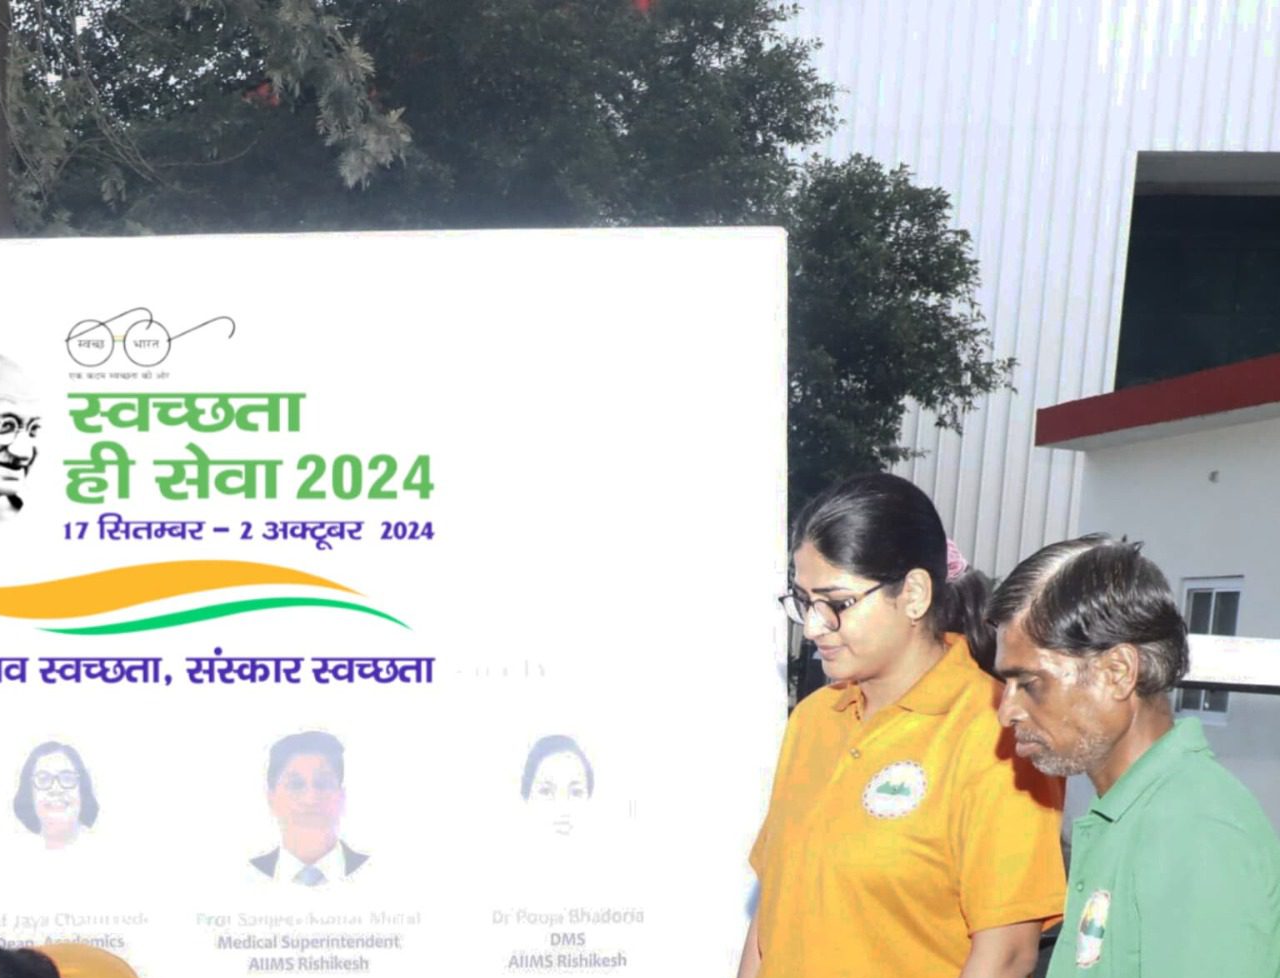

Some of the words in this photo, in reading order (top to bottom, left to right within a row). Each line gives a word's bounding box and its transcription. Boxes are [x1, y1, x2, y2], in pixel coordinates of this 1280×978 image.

[133, 339, 160, 349] भारत
[67, 392, 307, 434] स्वच्छता
[63, 440, 136, 505] ही
[153, 442, 284, 500] सेवा
[296, 454, 435, 500] 2024
[63, 521, 89, 541] 17
[96, 512, 207, 541] सितम्बर
[239, 521, 254, 541] 2
[261, 520, 365, 551] अक्टूबर
[380, 521, 436, 541] 2024
[37, 656, 173, 687] स्वच्छता,
[184, 647, 305, 685] संस्कार
[311, 656, 437, 685] स्वच्छता
[218, 935, 277, 950] Medical
[281, 934, 400, 952] Superintendent
[550, 932, 586, 946] DMS
[248, 956, 294, 971] AIIMS
[298, 955, 370, 971] Rishikesh
[508, 954, 553, 969] AIIMS
[557, 952, 628, 968] Rishikesh
